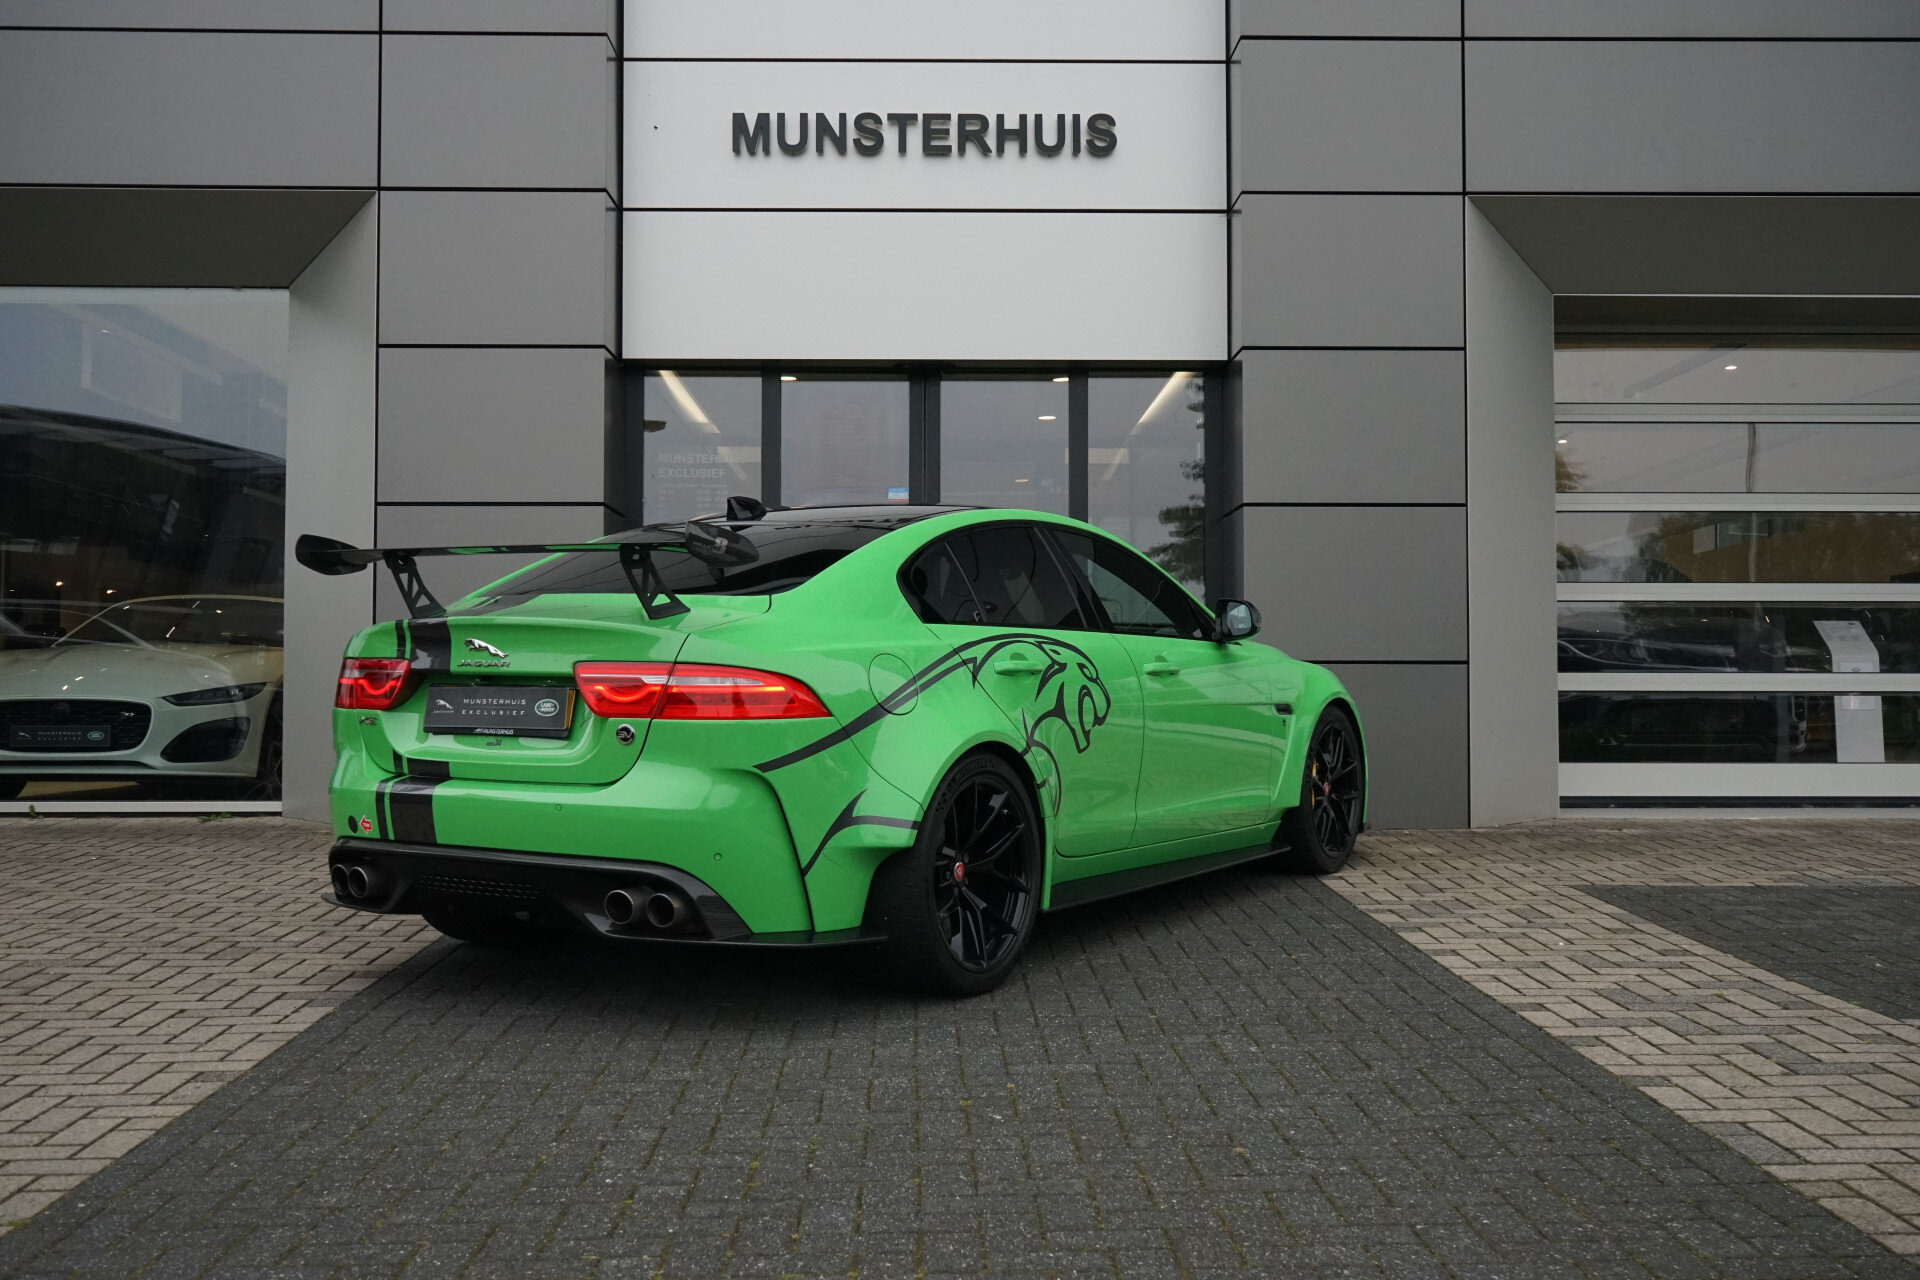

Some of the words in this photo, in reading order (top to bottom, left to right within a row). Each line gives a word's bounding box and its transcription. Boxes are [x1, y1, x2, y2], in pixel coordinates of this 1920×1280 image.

[731, 112, 1118, 157] MUNSTERHUIS
[659, 468, 728, 479] EXCLUSIEF
[457, 659, 511, 669] JAGUAR
[462, 698, 527, 706] MUNSTERHUIS
